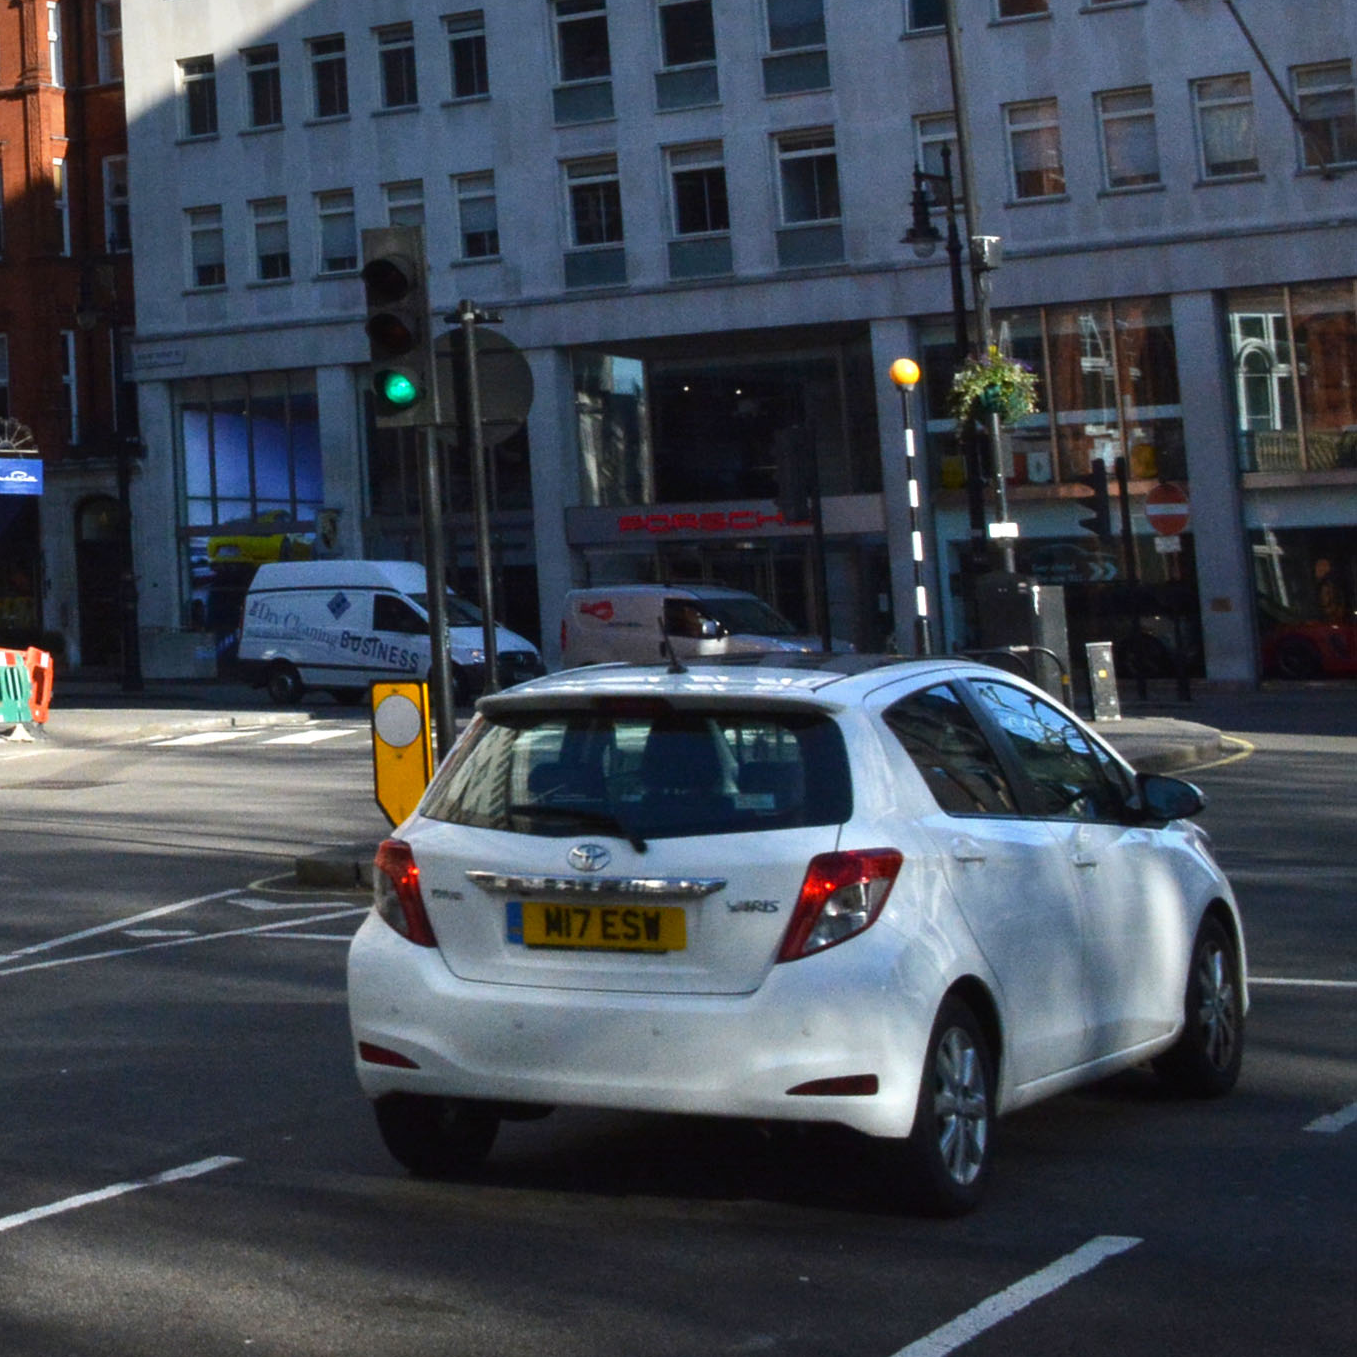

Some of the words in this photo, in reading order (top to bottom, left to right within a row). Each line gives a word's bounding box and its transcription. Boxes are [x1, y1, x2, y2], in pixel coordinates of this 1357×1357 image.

[619, 511, 814, 534] PORSCH
[340, 630, 420, 670] BUSINESS
[601, 909, 660, 941] ESW
